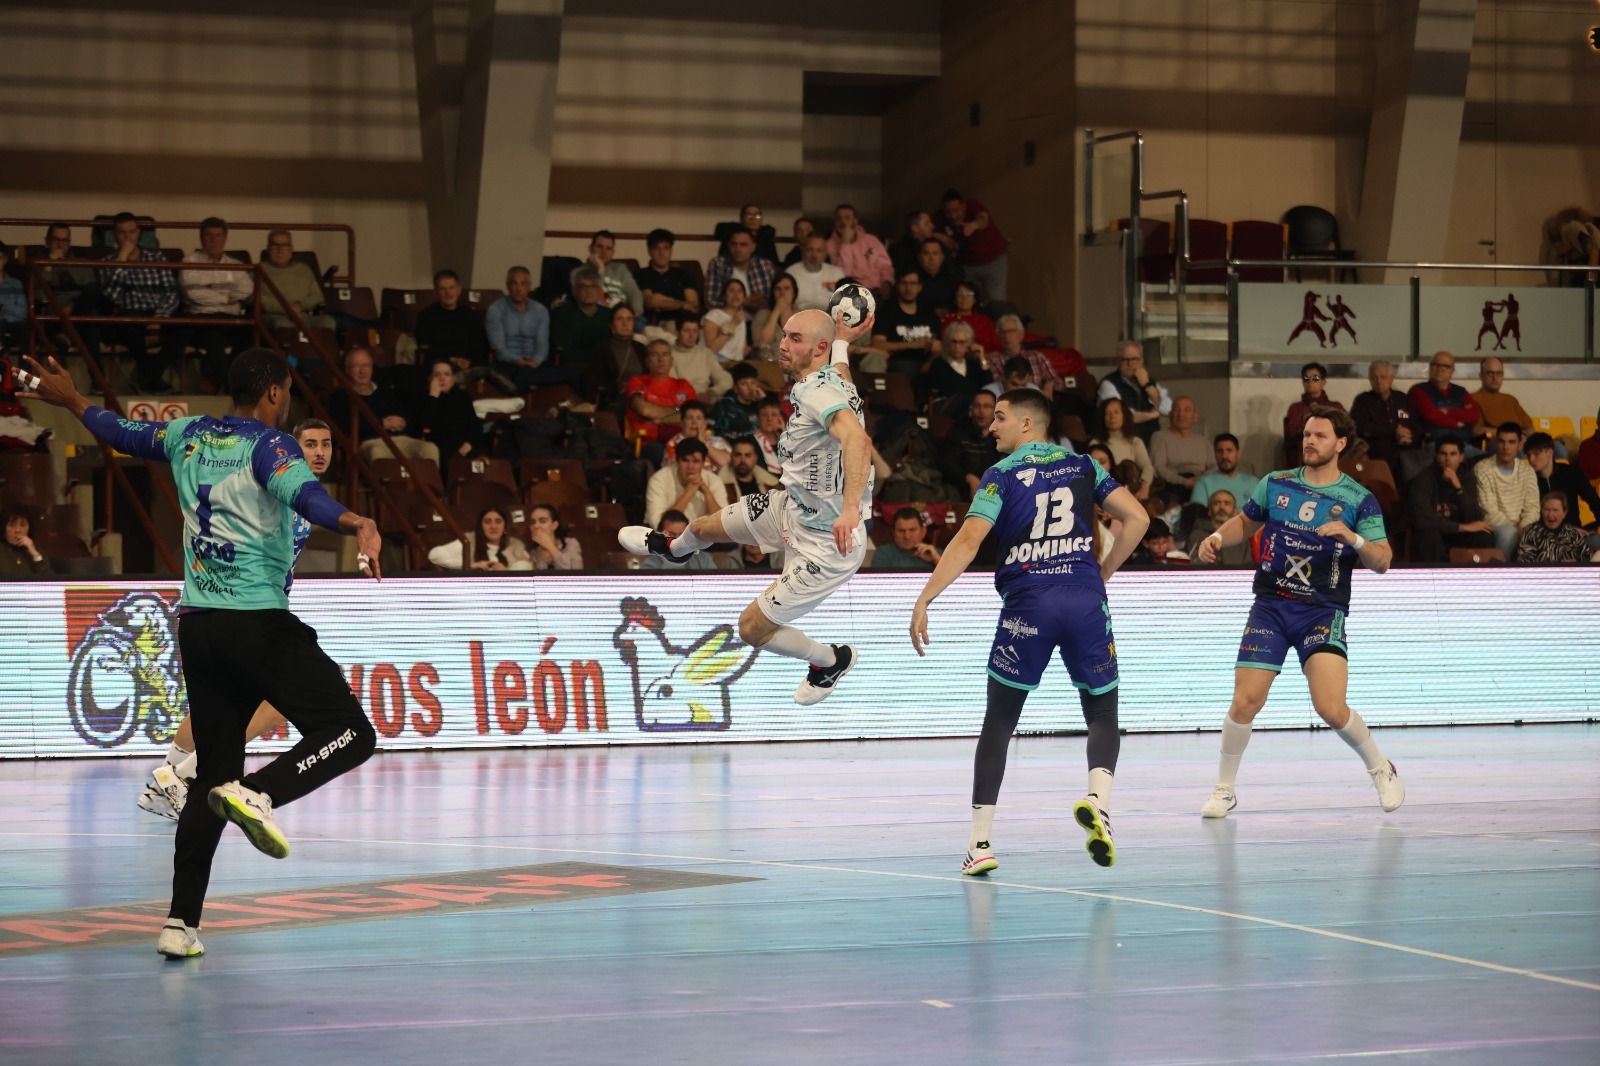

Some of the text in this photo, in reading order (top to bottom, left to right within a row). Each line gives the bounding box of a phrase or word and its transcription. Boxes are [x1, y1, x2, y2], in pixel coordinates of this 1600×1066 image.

[806, 454, 818, 492] Finura
[1029, 486, 1075, 540] 13
[1298, 500, 1318, 523] 6
[1284, 535, 1323, 552] Cajasol
[992, 658, 1020, 676] MORENA
[469, 636, 609, 735] león
